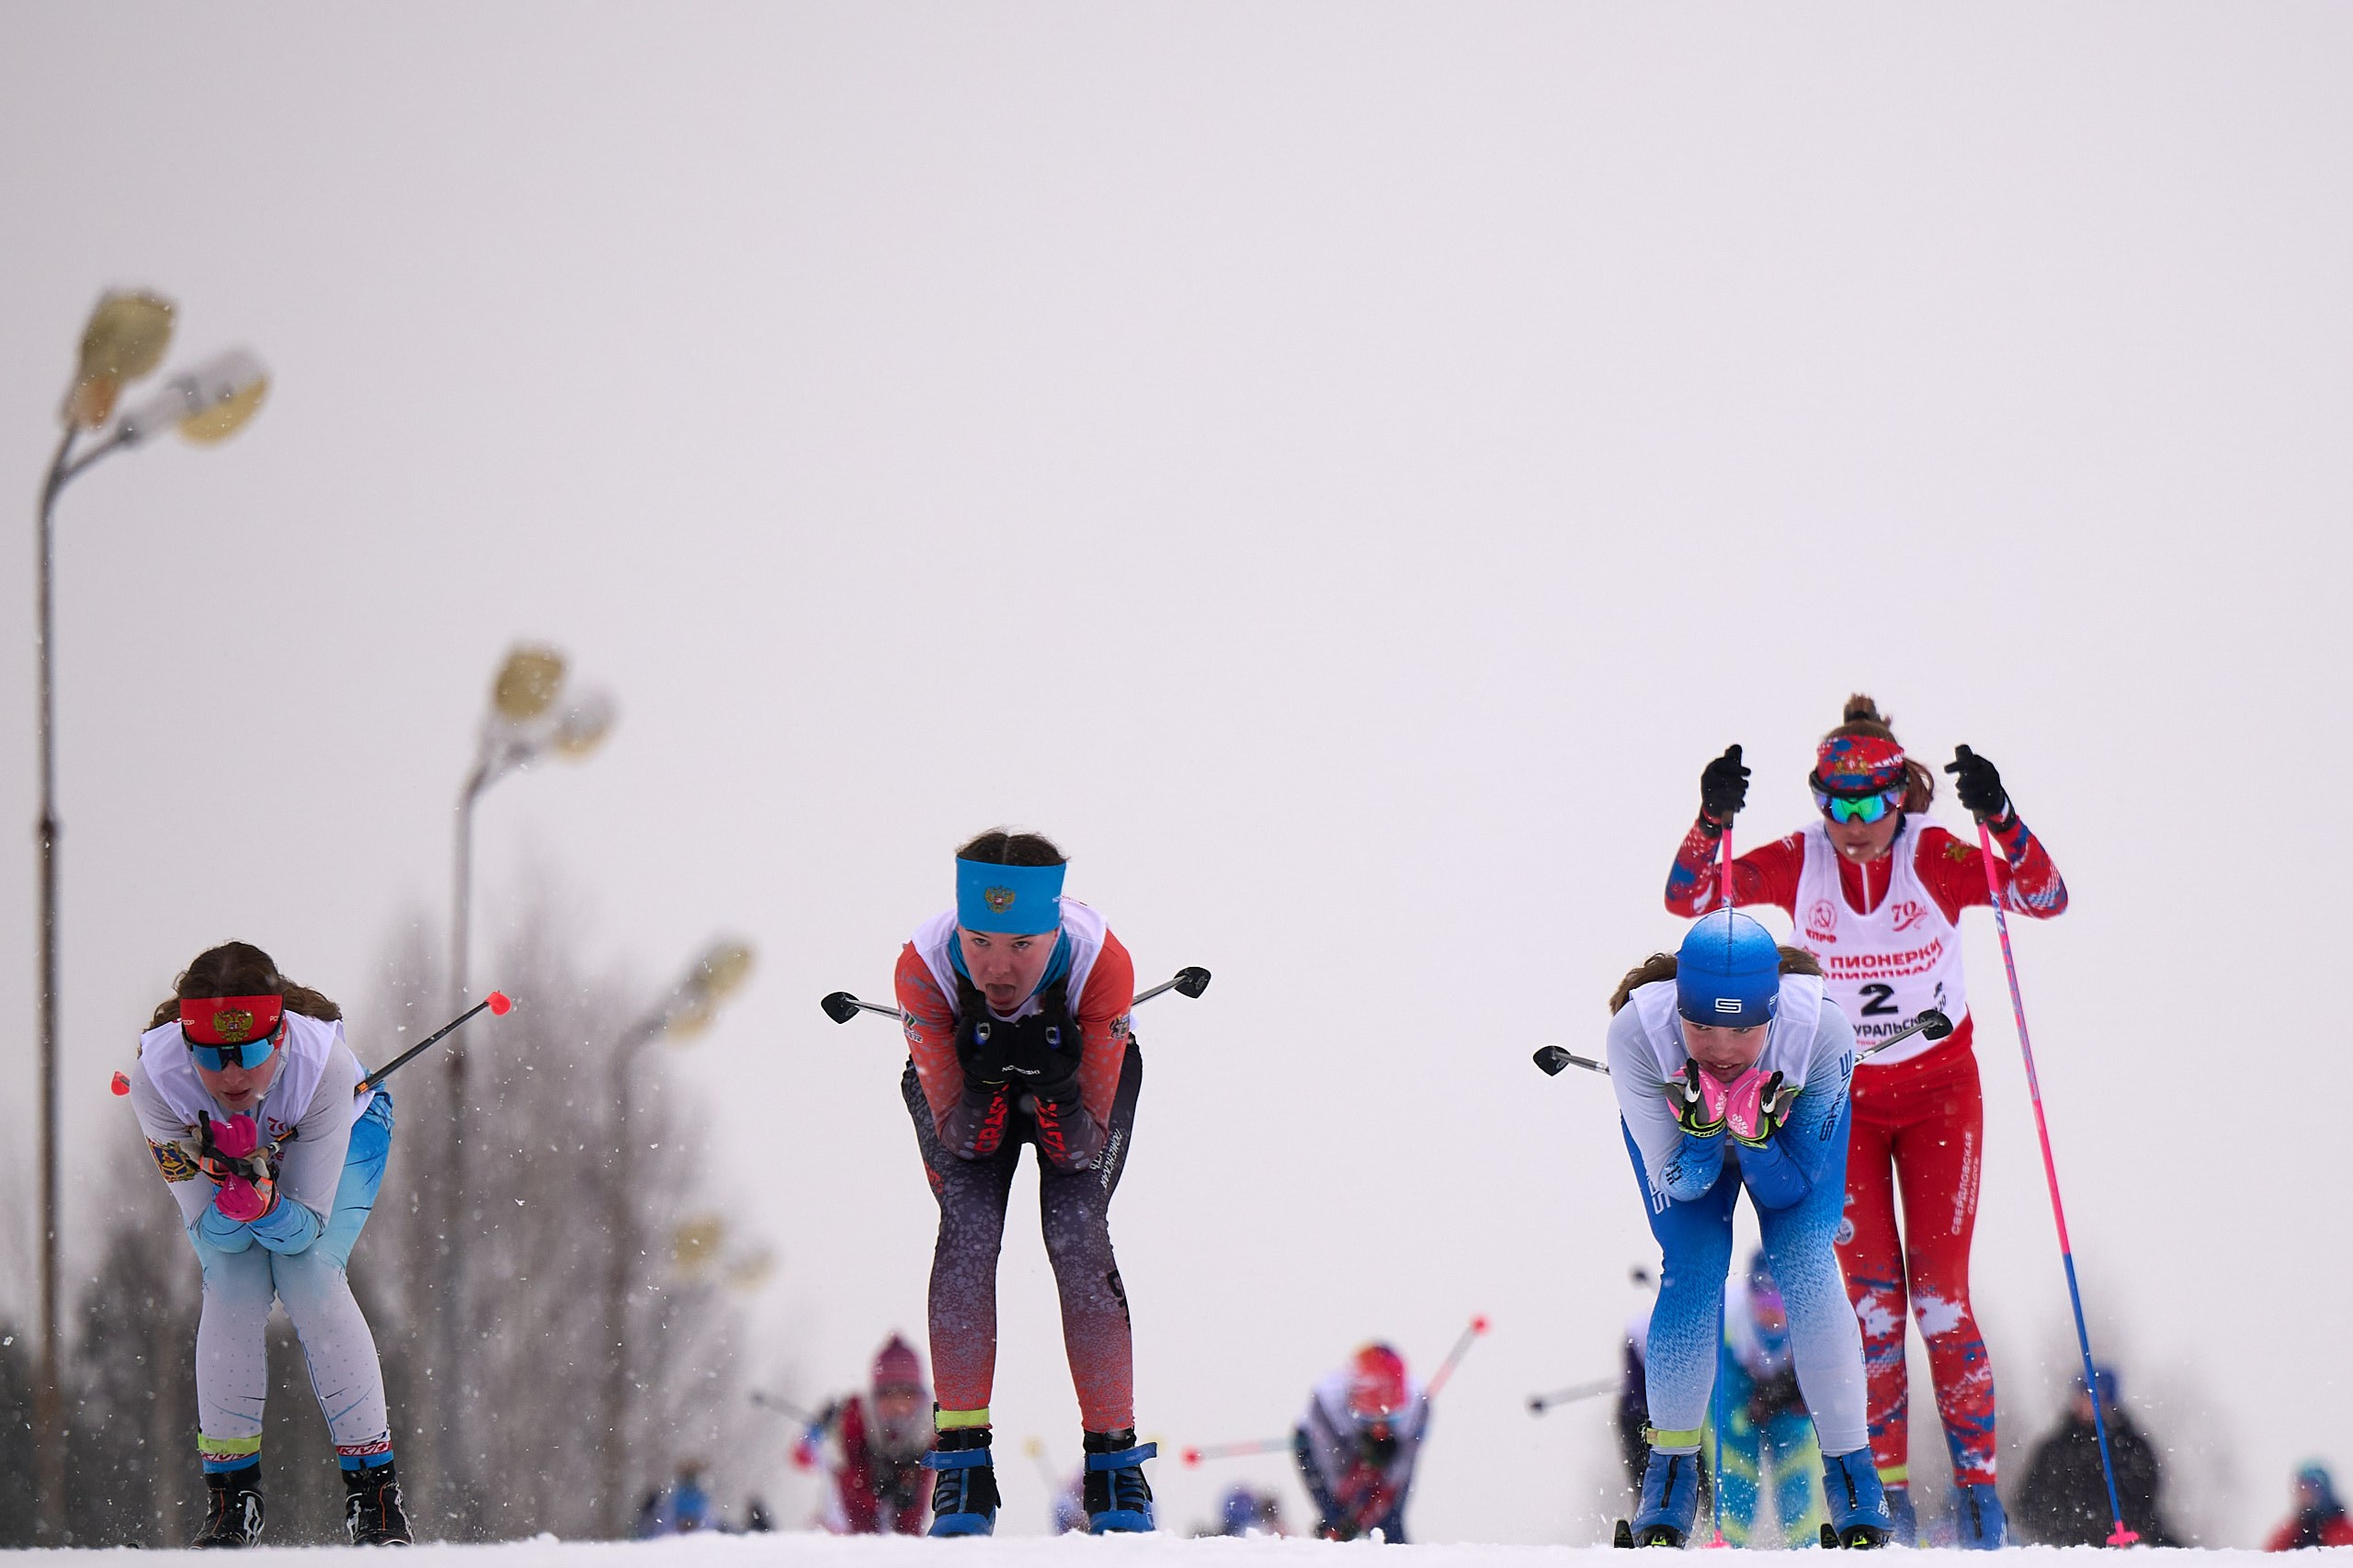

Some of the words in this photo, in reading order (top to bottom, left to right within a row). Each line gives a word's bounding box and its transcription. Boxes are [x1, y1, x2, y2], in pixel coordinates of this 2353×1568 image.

[1892, 901, 1916, 923] 70
[1859, 983, 1899, 1017] 2
[1951, 1131, 1973, 1236] СВЕРДЛОВСКАЯ
